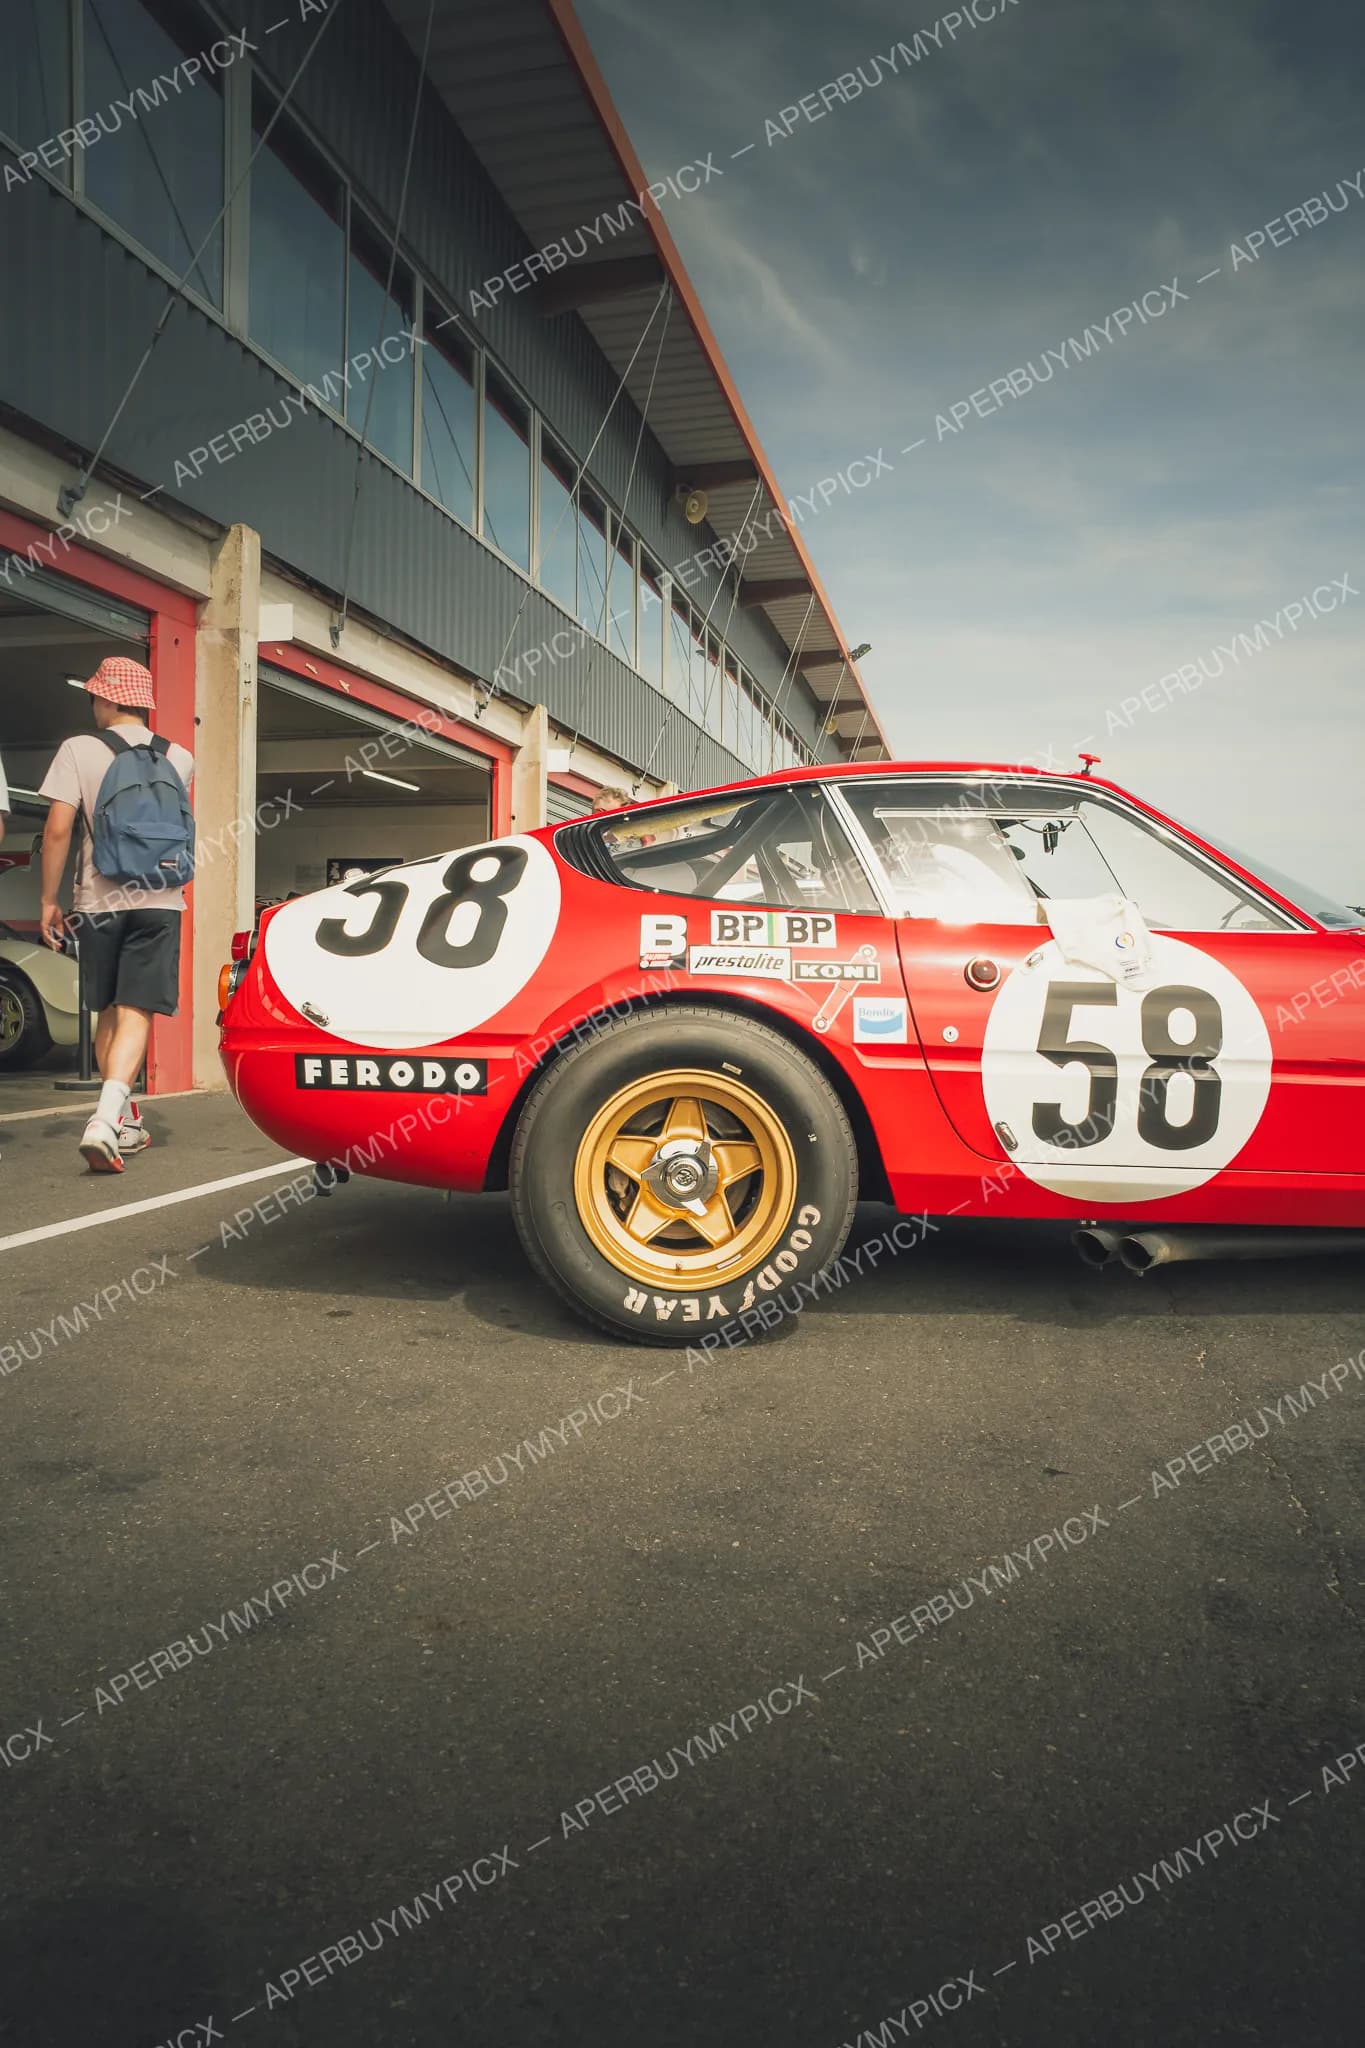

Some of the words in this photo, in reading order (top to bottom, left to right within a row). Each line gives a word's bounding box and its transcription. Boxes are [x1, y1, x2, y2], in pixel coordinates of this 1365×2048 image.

[315, 845, 528, 969] 58
[717, 914, 764, 942] BP
[785, 916, 832, 944] BP
[694, 953, 785, 970] prestolite
[799, 964, 876, 980] KONI
[304, 1059, 481, 1090] FERODO
[1031, 981, 1223, 1150] 58
